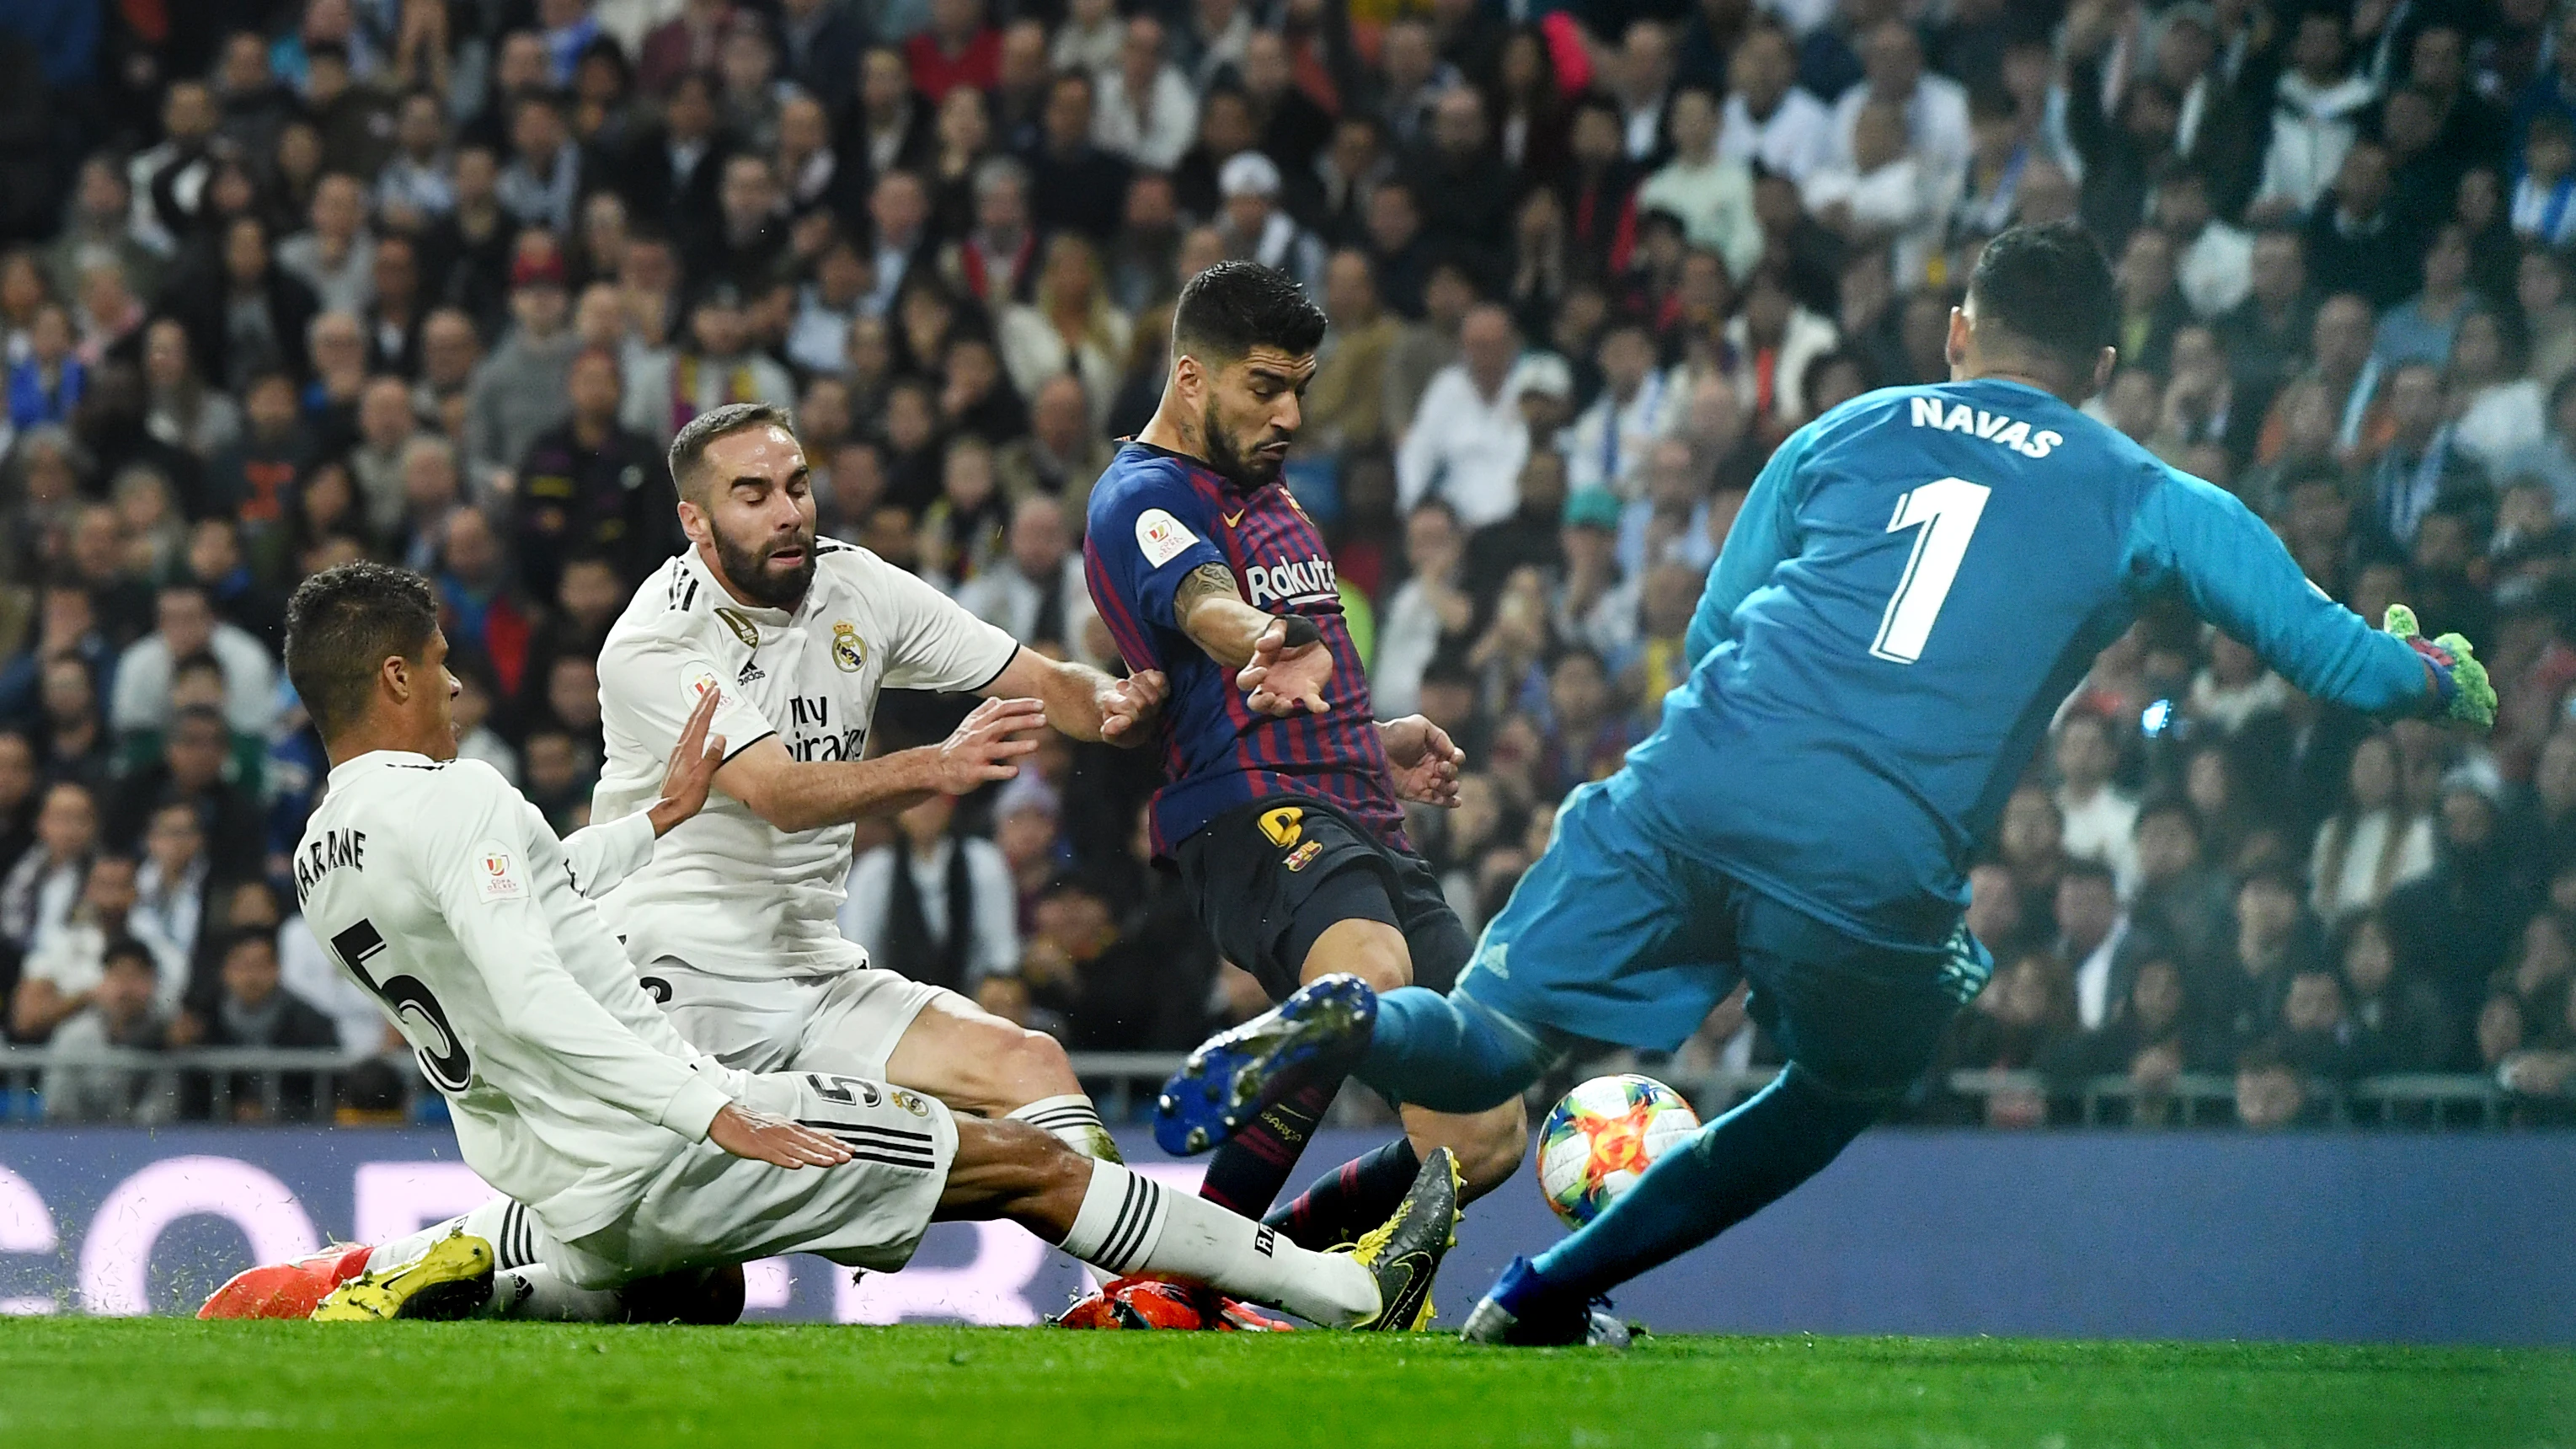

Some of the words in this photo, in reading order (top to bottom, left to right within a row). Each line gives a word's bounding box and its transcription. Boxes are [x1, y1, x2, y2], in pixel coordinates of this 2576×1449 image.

[1910, 397, 2064, 459] NAVAS
[1868, 476, 1992, 666] 1
[329, 917, 471, 1093] 5
[804, 1073, 882, 1108] 5
